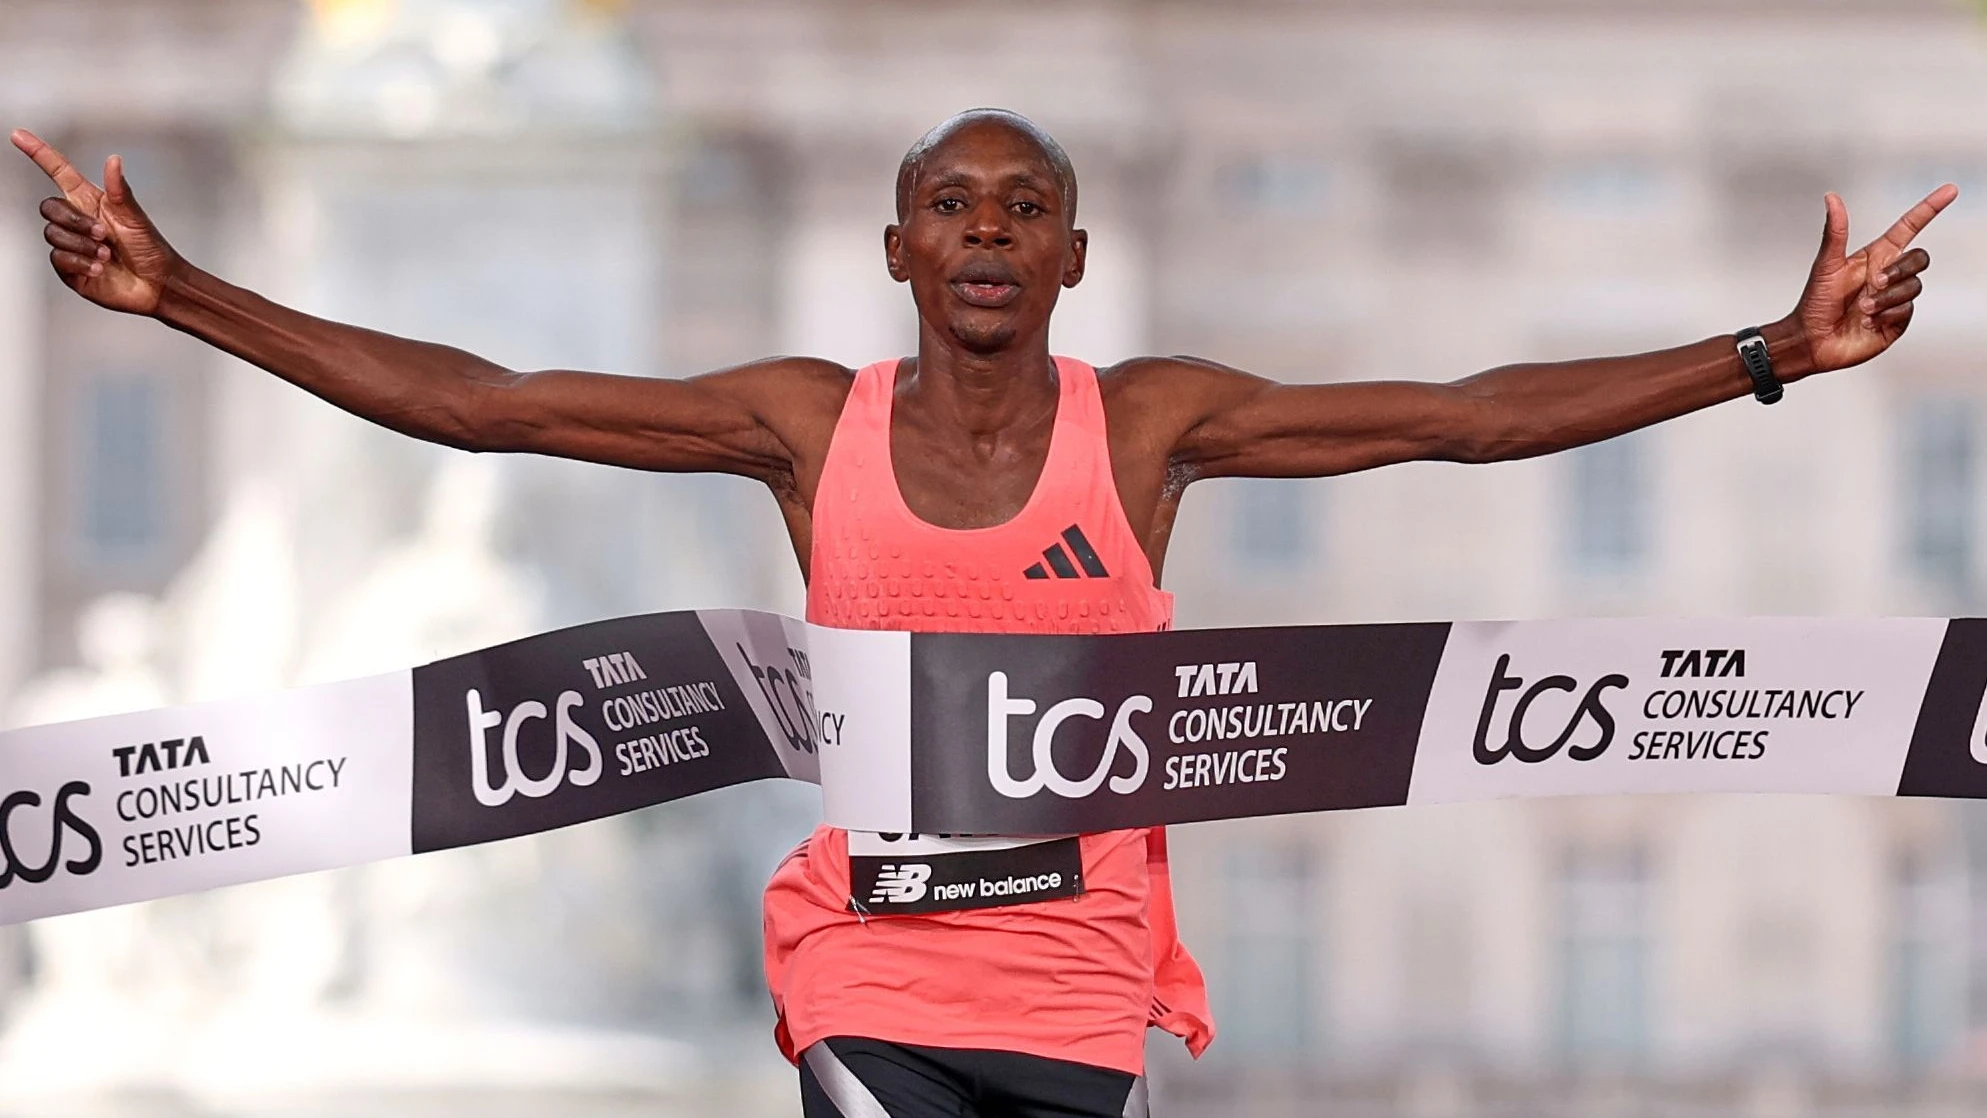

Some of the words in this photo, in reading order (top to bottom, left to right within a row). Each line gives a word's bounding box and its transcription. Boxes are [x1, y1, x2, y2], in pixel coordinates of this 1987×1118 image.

[582, 651, 648, 689] TATA
[1175, 661, 1258, 697] TATA
[1660, 649, 1746, 678] TATA
[602, 681, 726, 732] CONSULTANCY
[1168, 699, 1373, 744] CONSULTANCY
[1472, 653, 1630, 765] tcs
[1643, 689, 1865, 719] CONSULTANCY
[112, 736, 210, 777] TATA
[467, 688, 603, 806] tcs
[615, 725, 710, 776] SERVICES
[988, 671, 1153, 798] tcs
[1627, 730, 1769, 760] SERVICES
[116, 757, 348, 822] CONSULTANCY
[1163, 747, 1288, 790] SERVICES
[0, 780, 103, 890] cs
[122, 814, 262, 867] SERVICES
[933, 882, 976, 901] new
[979, 872, 1062, 897] balance
